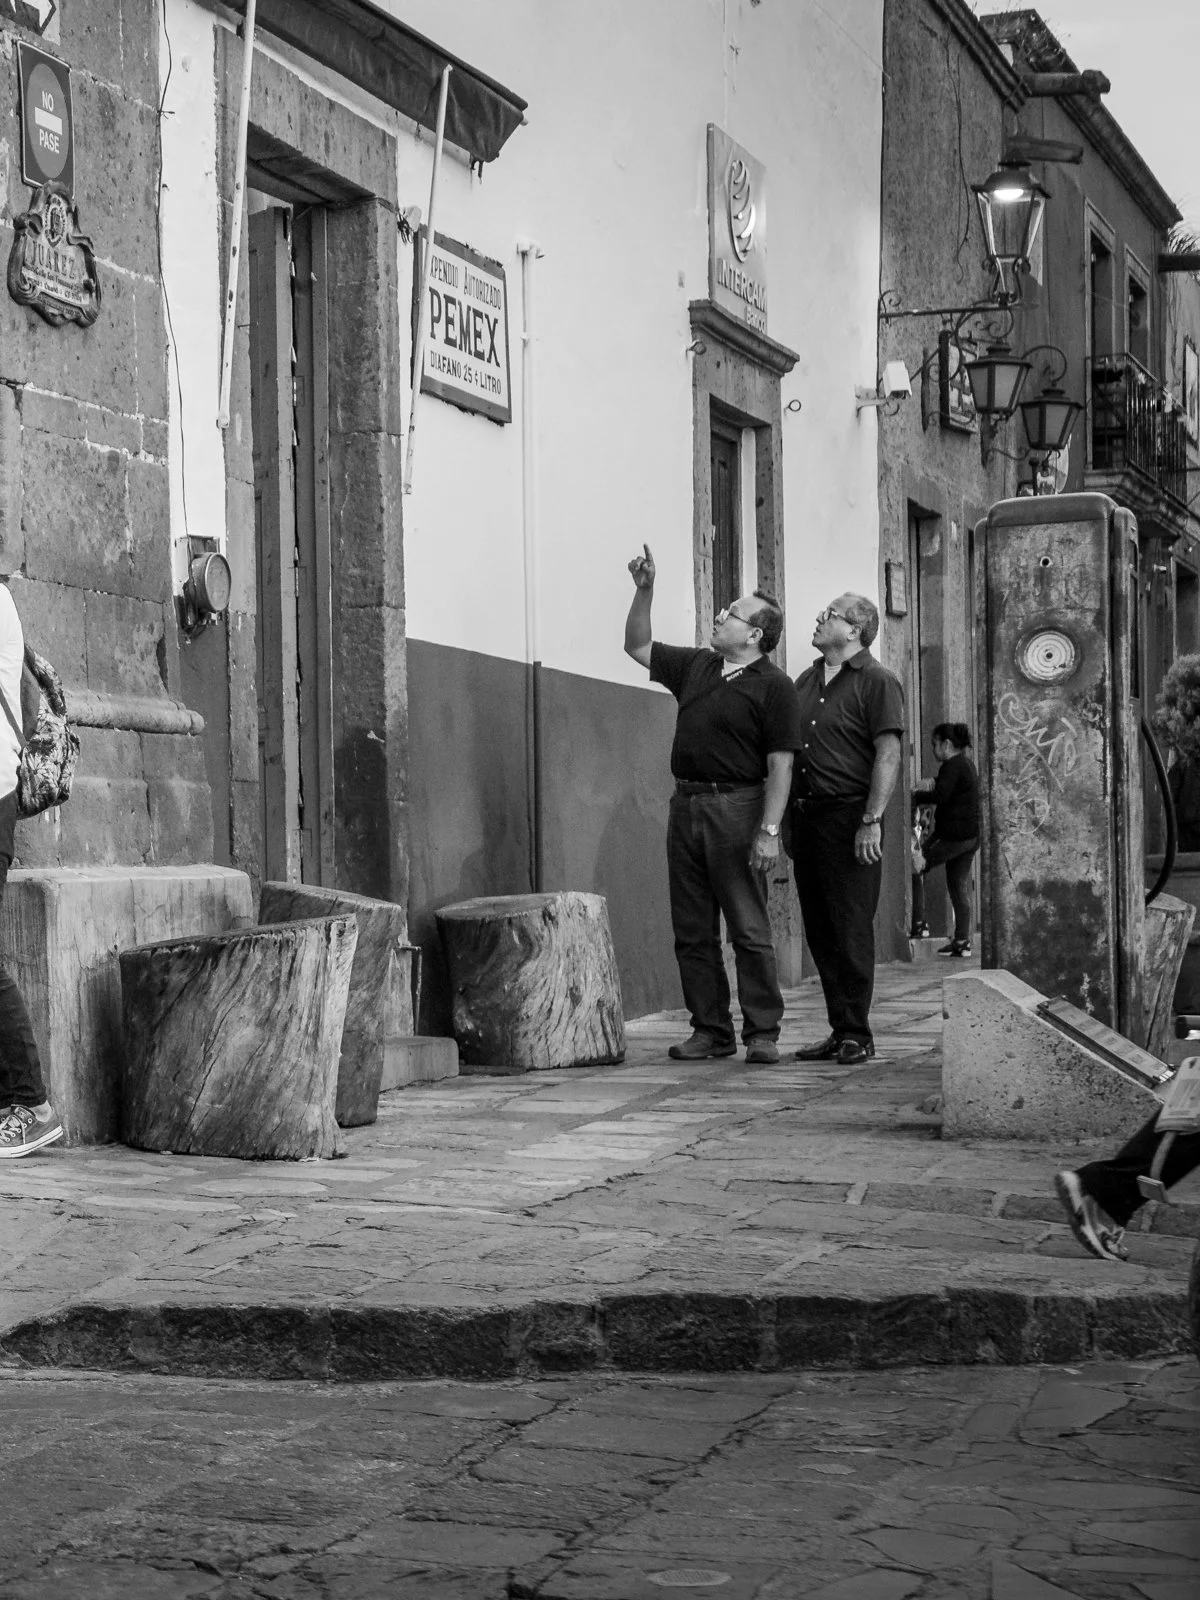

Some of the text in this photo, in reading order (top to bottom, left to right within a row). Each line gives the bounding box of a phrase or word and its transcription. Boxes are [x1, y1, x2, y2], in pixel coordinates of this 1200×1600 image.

[42, 90, 54, 112] NO
[39, 128, 60, 154] PASE
[430, 255, 502, 310] XPENDIO AUTORIZADO
[717, 259, 766, 313] INTERCAM
[428, 286, 501, 368] PEMEX
[745, 306, 767, 336] Banco
[430, 350, 462, 379] DIAFANO
[463, 363, 473, 384] 25
[480, 371, 502, 395] LITRO
